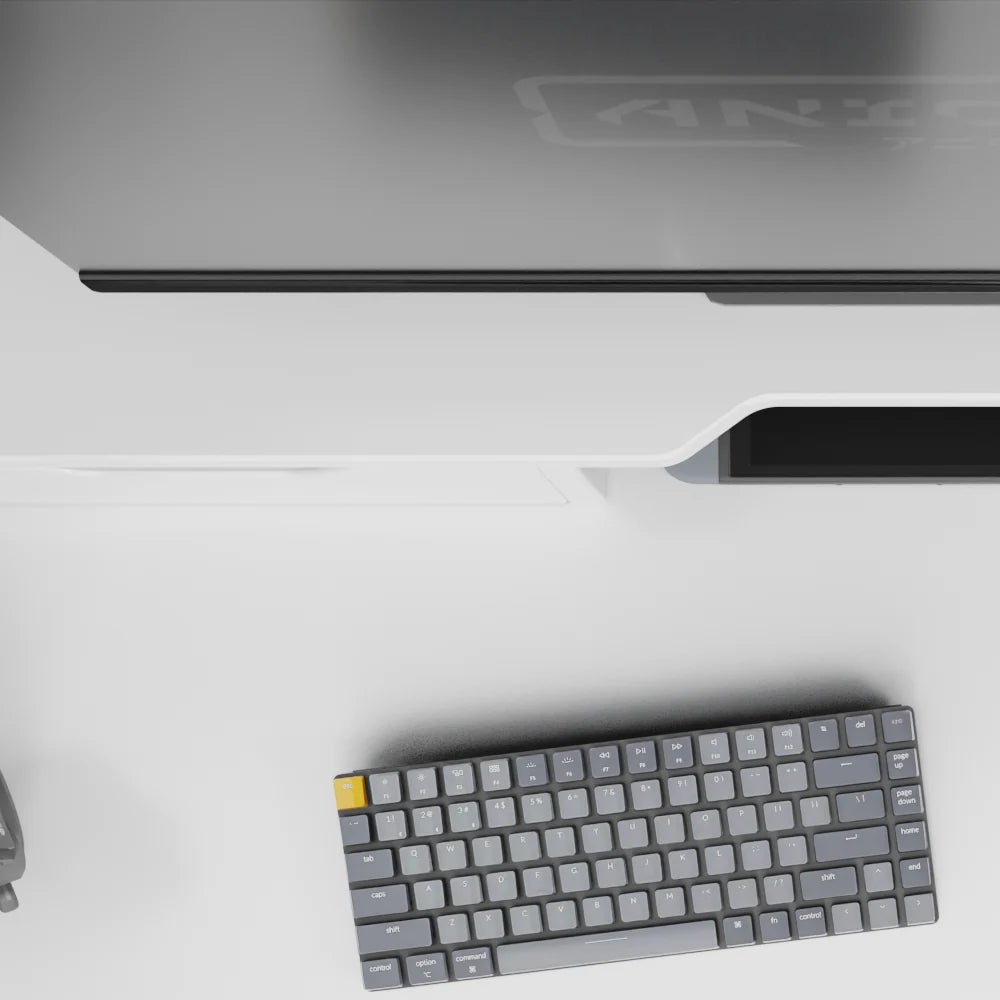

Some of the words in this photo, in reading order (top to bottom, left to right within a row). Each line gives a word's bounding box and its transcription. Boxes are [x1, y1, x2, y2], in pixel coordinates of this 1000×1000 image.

[855, 720, 866, 729] del
[893, 752, 909, 761] page
[894, 761, 904, 769] up
[896, 789, 913, 798] page
[897, 797, 916, 806] down
[900, 827, 919, 836] home
[484, 840, 490, 848] E
[410, 849, 418, 857] Q
[821, 873, 836, 882] shift
[370, 890, 386, 899] caps
[799, 911, 822, 921] control
[386, 926, 400, 934] shift
[455, 952, 487, 962] command
[415, 959, 437, 968] option
[369, 964, 392, 973] control
